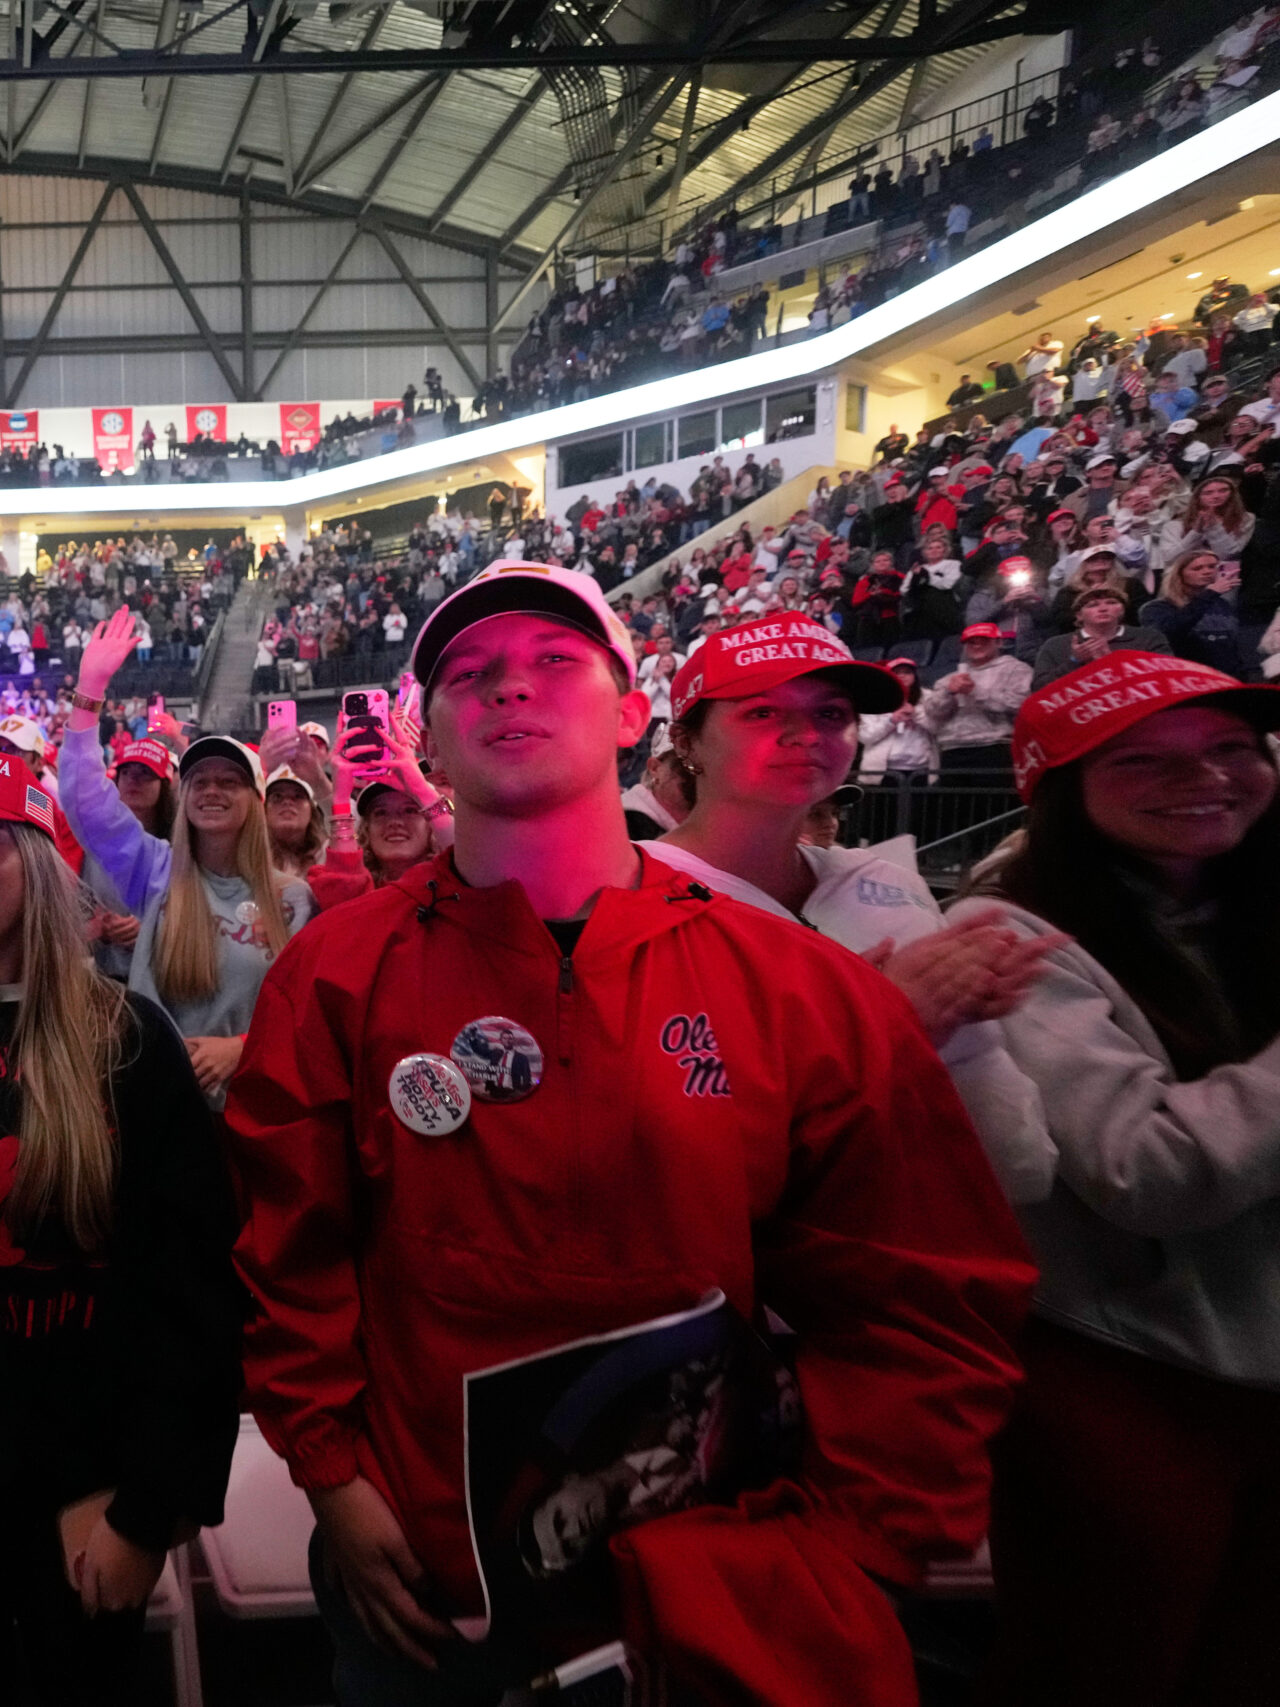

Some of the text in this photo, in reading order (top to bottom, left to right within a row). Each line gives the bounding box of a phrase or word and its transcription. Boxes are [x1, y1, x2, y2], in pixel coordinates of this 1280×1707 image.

[721, 623, 784, 650] MAKE
[735, 642, 808, 667] GREAT
[1038, 668, 1120, 714] MAKE
[1071, 680, 1162, 725] GREAT
[660, 1012, 720, 1056] Ole
